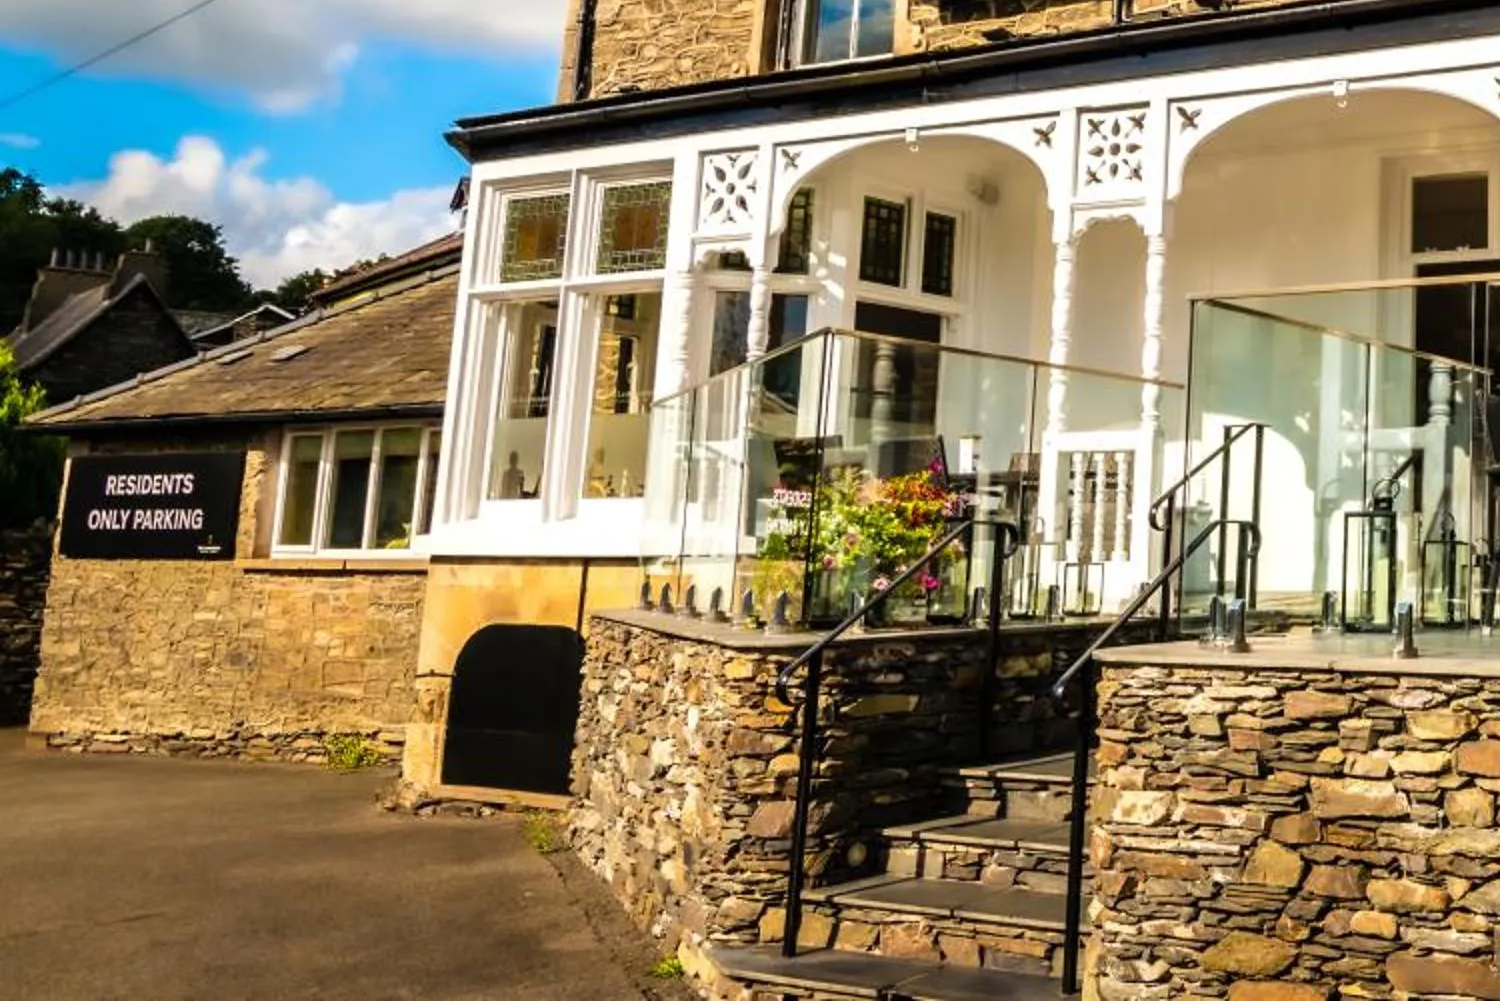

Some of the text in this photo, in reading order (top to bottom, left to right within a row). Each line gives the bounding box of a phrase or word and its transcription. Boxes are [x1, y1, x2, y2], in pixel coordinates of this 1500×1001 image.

[105, 474, 194, 496] RESIDENTS
[87, 508, 204, 530] ONLY PARKING
